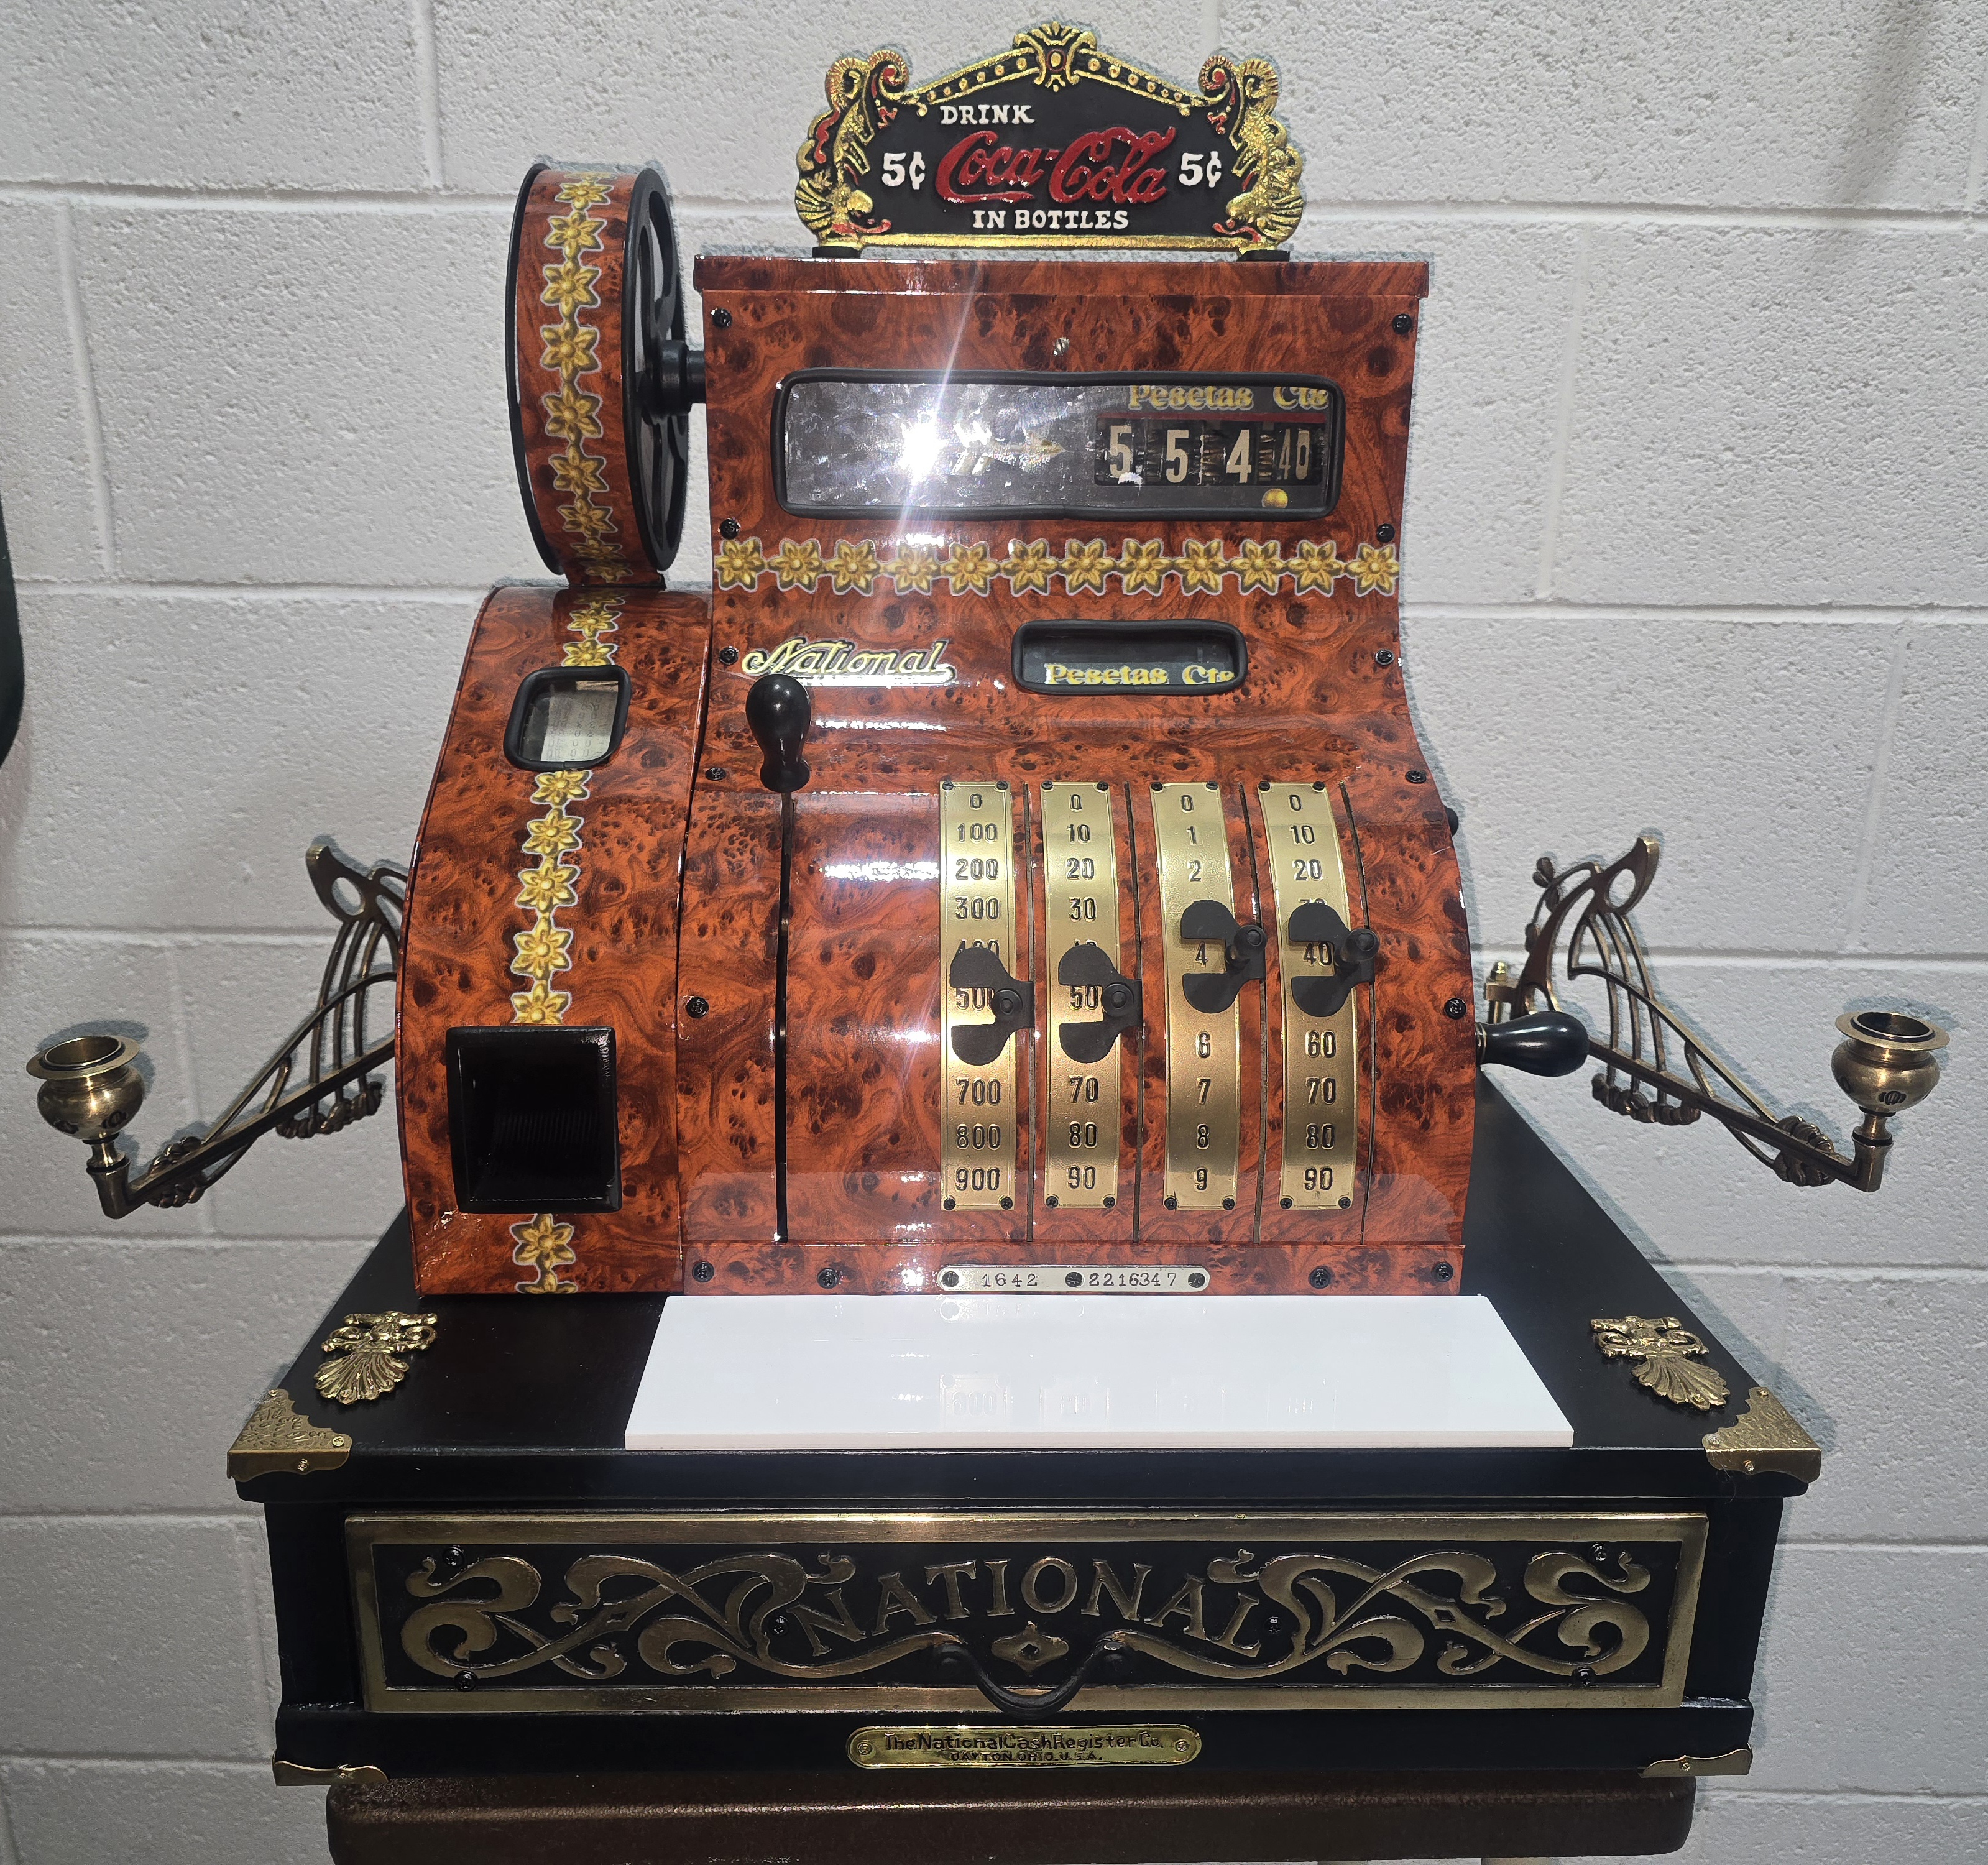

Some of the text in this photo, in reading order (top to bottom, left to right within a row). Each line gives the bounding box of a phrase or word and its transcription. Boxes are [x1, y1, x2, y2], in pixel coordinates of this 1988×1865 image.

[940, 104, 1034, 124] DRINK
[883, 151, 927, 190] 5¢
[934, 126, 1176, 205] Coca-Cola
[1177, 151, 1223, 189] 5¢
[973, 210, 1130, 230] IN BOTTLES
[1128, 385, 1328, 410] Pesetas Cts
[1110, 425, 1310, 484] 5 5 4 40
[742, 637, 957, 686] National
[1044, 662, 1171, 684] Pesetas
[970, 794, 982, 809] 0
[1070, 794, 1082, 811] 0
[1181, 794, 1194, 813] 0
[1289, 794, 1302, 811] 0
[957, 822, 997, 843] 100
[1067, 824, 1090, 844] 10
[1186, 826, 1197, 845] 1
[1291, 824, 1315, 845] 10
[955, 858, 998, 880] 200
[1066, 858, 1094, 880] 20
[1188, 860, 1202, 882] 2
[1294, 859, 1322, 881] 20
[955, 897, 999, 920] 300
[1069, 897, 1096, 921] 30
[1195, 942, 1208, 967] 4
[1303, 942, 1332, 966] 40
[1070, 985, 1098, 1010] 50
[1197, 1031, 1210, 1059] 6
[1305, 1031, 1337, 1058] 60
[955, 1077, 1001, 1105] 700
[1069, 1076, 1099, 1103] 70
[1197, 1079, 1211, 1105] 7
[1305, 1077, 1337, 1105] 70
[956, 1124, 1001, 1150] 800
[1069, 1123, 1098, 1148] 80
[1197, 1124, 1210, 1149] 8
[1307, 1124, 1335, 1149] 80
[955, 1167, 1000, 1191] 900
[1068, 1166, 1096, 1190] 90
[1195, 1166, 1208, 1191] 9
[1304, 1167, 1333, 1191] 90
[982, 1273, 1177, 1287] 1642 2216347
[787, 1557, 1262, 1657] NATIONAL
[950, 1751, 1013, 1761] DAYTON
